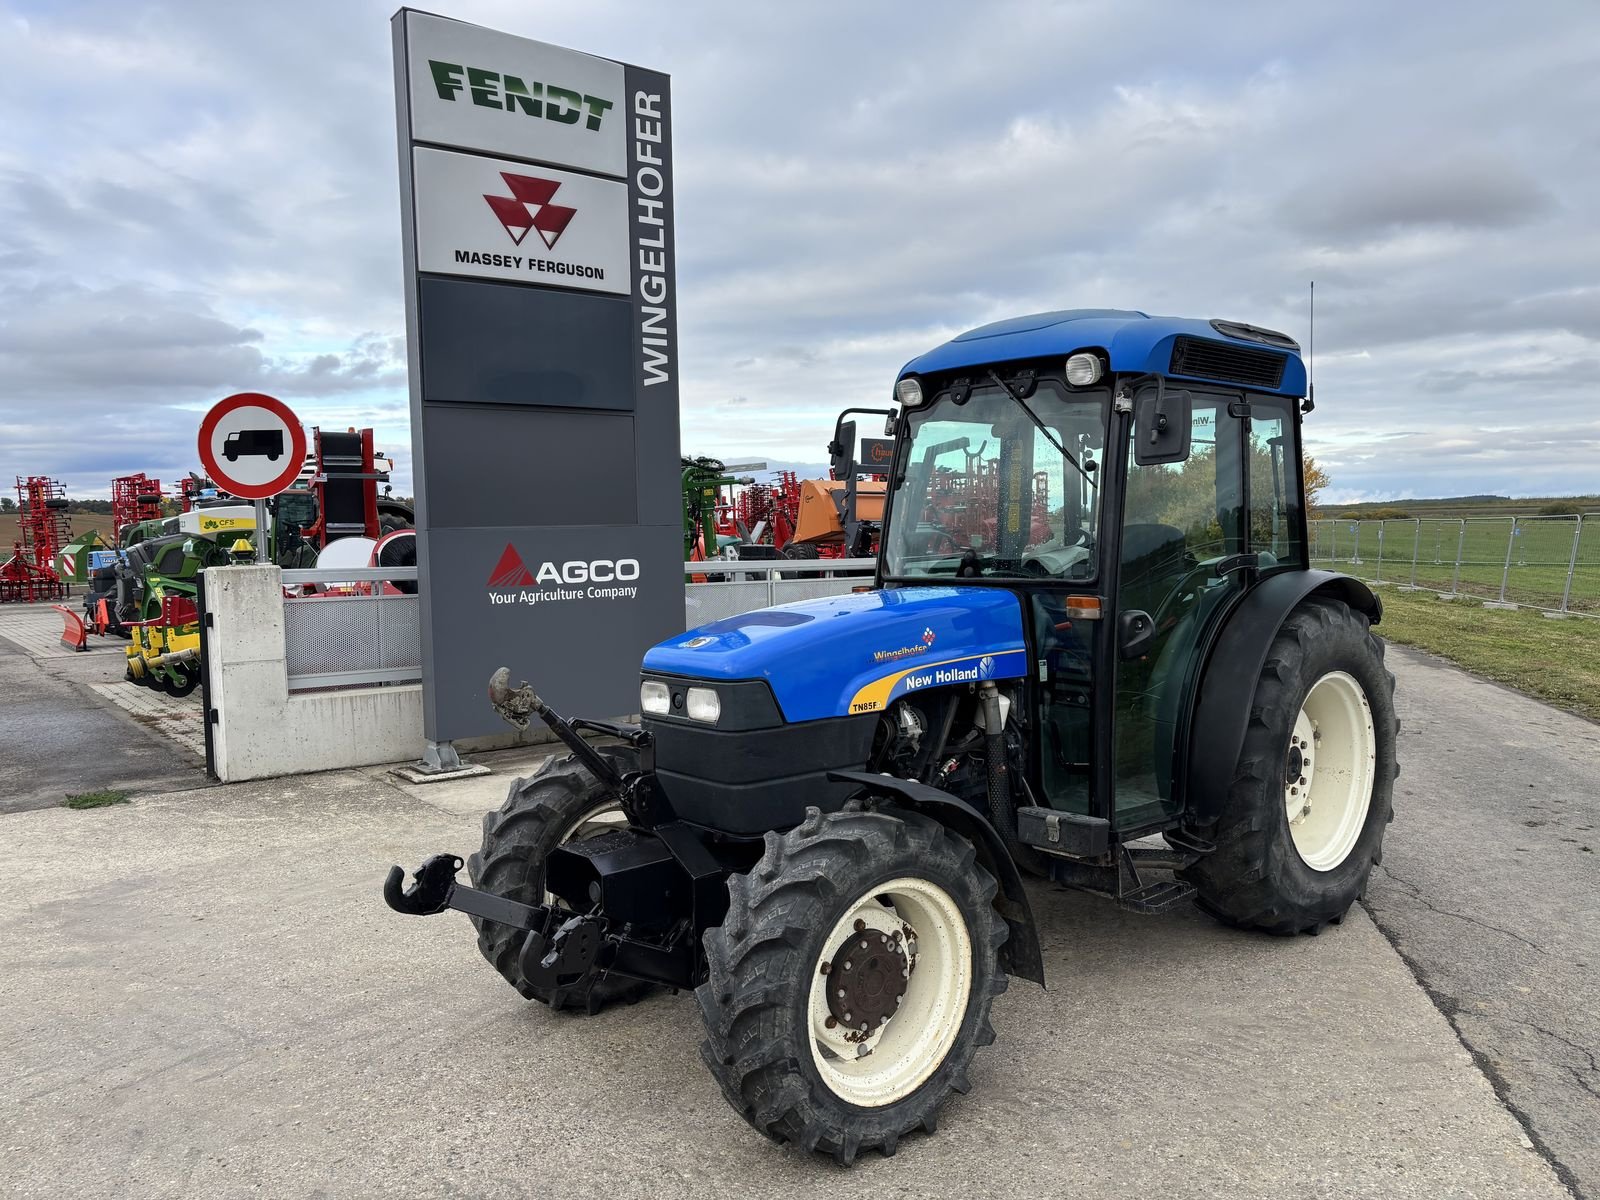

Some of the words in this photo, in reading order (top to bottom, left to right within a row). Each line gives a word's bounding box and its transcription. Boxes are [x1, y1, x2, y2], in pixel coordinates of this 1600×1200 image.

[428, 59, 614, 132] FENDT
[635, 90, 669, 386] WINGELHOFER
[455, 249, 523, 269] MASSEY
[528, 258, 605, 280] FERGUSON
[536, 558, 640, 585] AGCO
[488, 592, 517, 605] Your
[519, 588, 584, 606] Agriculture
[587, 586, 638, 600] Company
[906, 674, 933, 691] New
[935, 666, 978, 684] Holland
